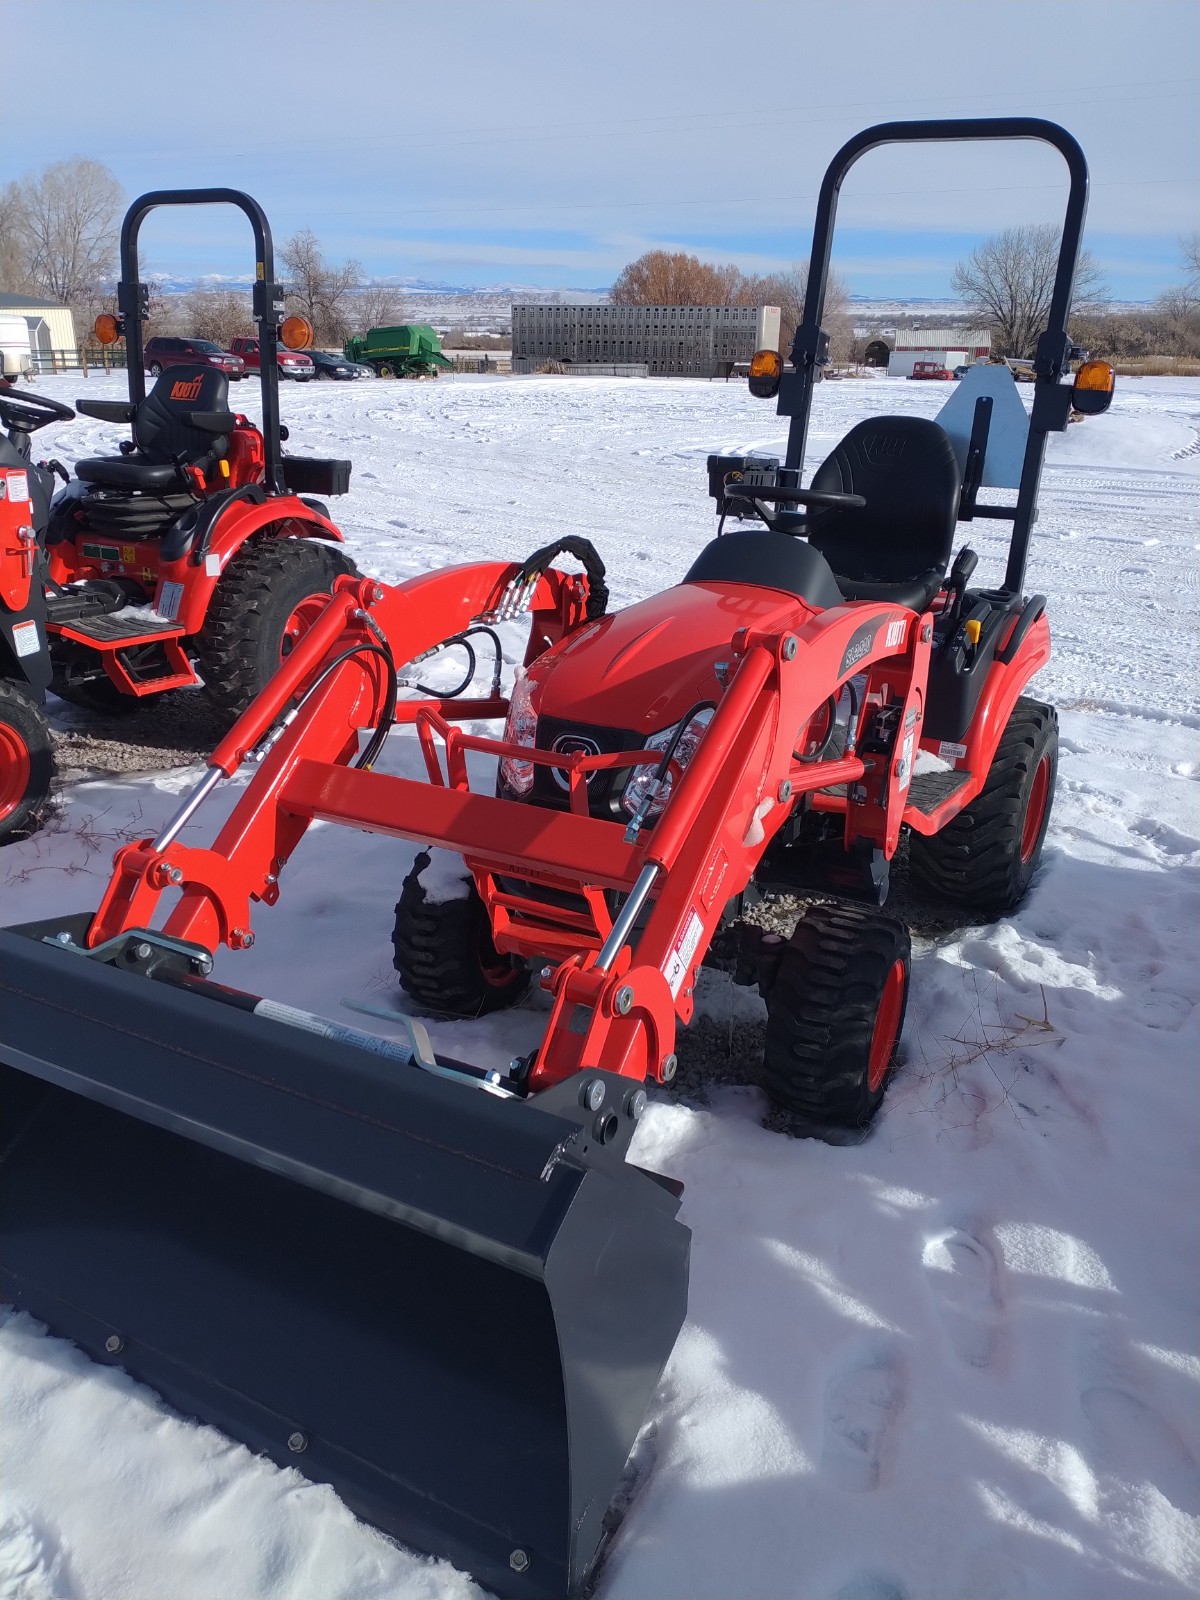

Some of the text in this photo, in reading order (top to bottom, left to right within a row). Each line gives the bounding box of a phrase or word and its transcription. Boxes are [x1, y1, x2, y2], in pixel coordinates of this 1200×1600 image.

[170, 381, 203, 399] KIOTI
[885, 619, 908, 648] KIOTI
[679, 911, 694, 941] DANGER
